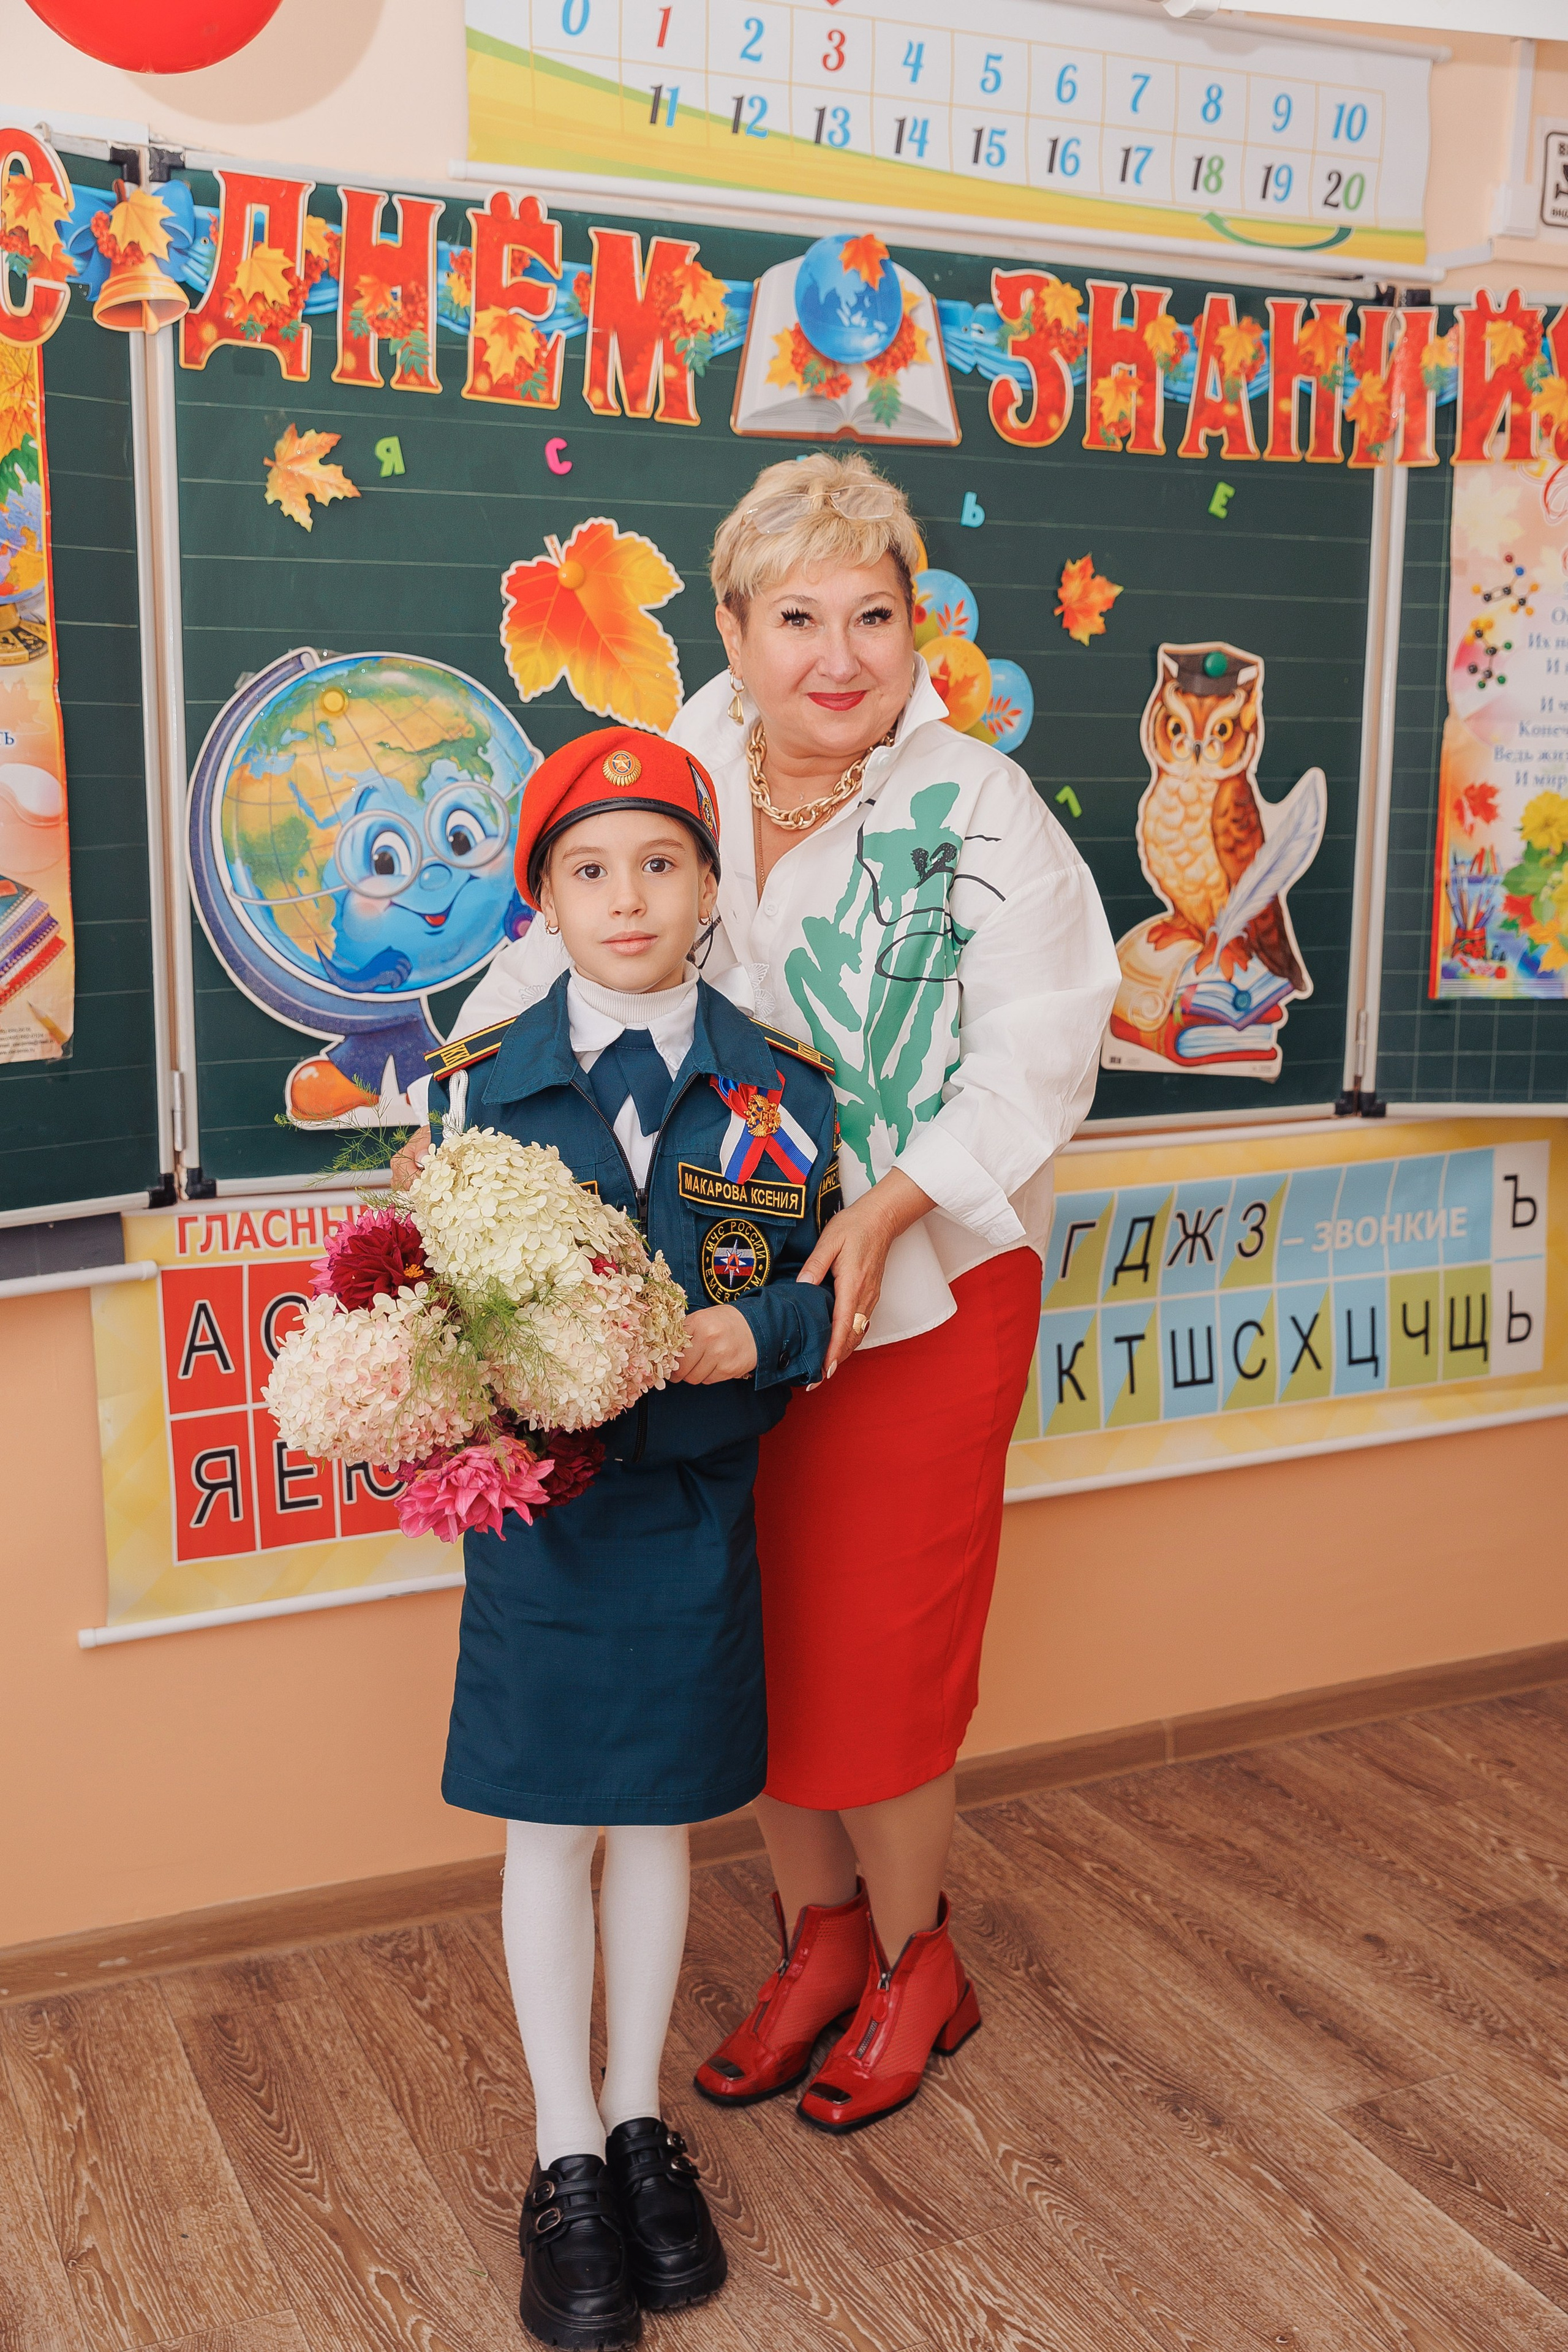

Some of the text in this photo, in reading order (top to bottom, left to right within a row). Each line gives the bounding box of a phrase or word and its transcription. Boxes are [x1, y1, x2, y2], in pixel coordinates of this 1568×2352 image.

[656, 6, 673, 48] 1
[740, 17, 764, 62] 2
[822, 29, 847, 72] 3
[903, 40, 925, 83] 4
[980, 53, 1004, 94] 5
[1055, 63, 1078, 104] 6
[1129, 72, 1152, 115] 7
[1200, 83, 1224, 124] 8
[1271, 93, 1294, 133] 9
[1332, 102, 1368, 143] 10
[649, 83, 1366, 211] 11 12 13 14 15 16 17 18 19 20
[178, 168, 702, 426] ДНЁМ
[375, 435, 407, 478] Я
[178, 1205, 368, 1254] ГЛАСНЫ
[685, 1172, 799, 1210] МАКАРОВА КСЕНИЯ
[1060, 1221, 1097, 1279] Г
[1112, 1215, 1155, 1286] Д
[1166, 1207, 1224, 1268] Ж
[1236, 1202, 1268, 1259] З
[1311, 1207, 1468, 1253] ЗВОНКИЕ
[1504, 1174, 1538, 1228] Ъ
[706, 1221, 766, 1259] МЧС РОССИИ
[180, 1302, 233, 1378] А
[1057, 1289, 1532, 1404] К Т Ш С Х Ц Ч Щ Ь
[192, 1447, 242, 1526] Я
[276, 1440, 322, 1512] Е
